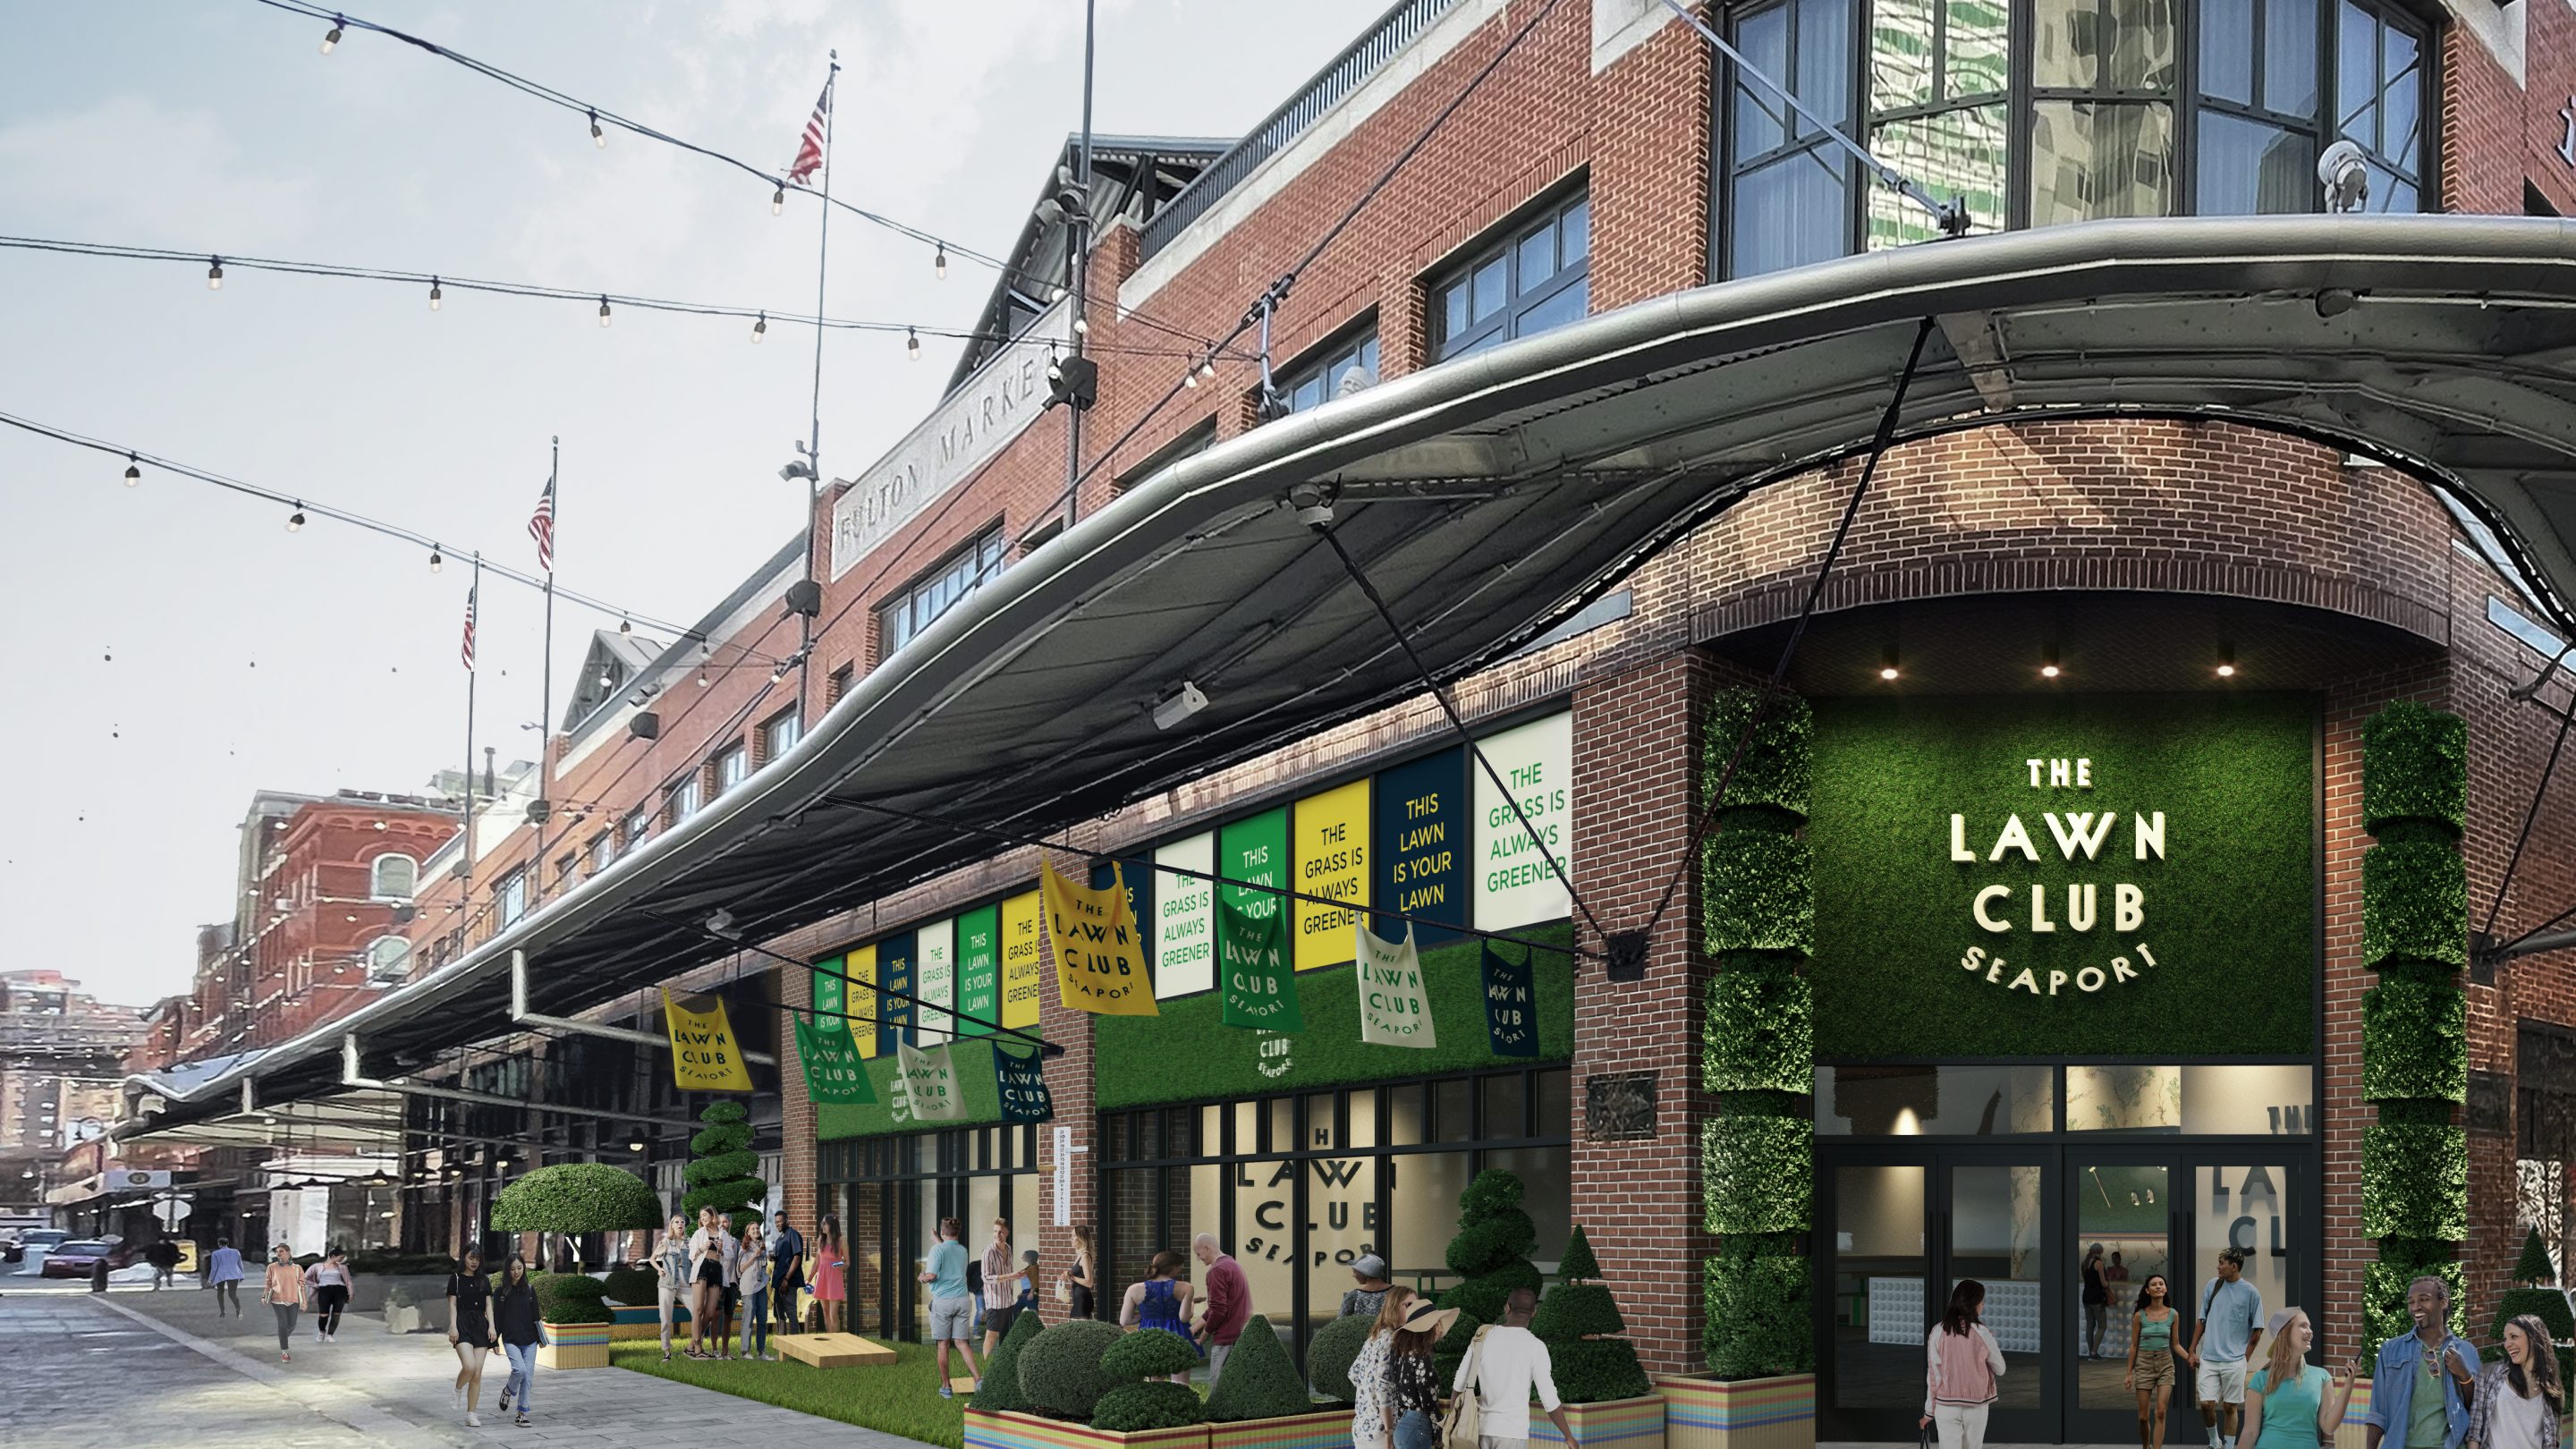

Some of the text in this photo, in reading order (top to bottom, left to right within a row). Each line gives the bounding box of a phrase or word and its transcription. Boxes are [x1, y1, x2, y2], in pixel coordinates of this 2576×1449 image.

[841, 464, 921, 549] FULTON
[1510, 762, 1543, 790] THE
[2027, 758, 2091, 788] THE
[1405, 792, 1438, 820] THIS
[1489, 789, 1565, 828] GRASS IS
[1321, 823, 1346, 846] THE
[1400, 822, 1445, 852] LAWN
[1490, 824, 1559, 860] ALWAYS
[1951, 811, 2165, 863] LAWN
[1243, 845, 1268, 869] THIS
[1305, 847, 1363, 879] GRASS IS
[1176, 869, 1196, 890] THE
[1394, 852, 1452, 885] IS YOUR
[1487, 856, 1567, 893] GREENER
[1239, 871, 1273, 896] LAWN
[1306, 877, 1358, 907] ALWAYS
[1076, 899, 1103, 916] THE
[1163, 891, 1209, 918] GRASS IS
[1246, 897, 1276, 919] YOUR
[1400, 884, 1445, 913] LAWN
[1973, 884, 2145, 932] CLUB
[1018, 919, 1032, 936] THE
[1055, 913, 1129, 945] LAWN
[1164, 918, 1205, 942] ALWAYS
[1239, 927, 1262, 942] THE
[970, 933, 987, 950] THIS
[1009, 941, 1033, 960] GRASS
[930, 947, 943, 962] THE
[968, 953, 989, 971] LAWN
[1064, 948, 1131, 976] CLUB
[1162, 942, 1209, 968] GREENER
[1226, 940, 1280, 967] LAWN
[1375, 950, 1395, 962] THE
[859, 970, 869, 982] THE
[892, 958, 905, 972] THIS
[922, 965, 951, 984] GRASS IS
[1009, 962, 1039, 981] ALWAYS
[1364, 962, 1419, 988] LAWN
[1494, 968, 1513, 981] THE
[1962, 942, 2157, 996] SEAPORT
[825, 979, 836, 993] THIS
[889, 976, 908, 992] LAWN
[965, 972, 993, 991] IS YOUR
[1068, 973, 1133, 999] SEAPORT
[823, 996, 838, 1011] LAWN
[852, 988, 869, 1003] GRASS
[924, 985, 949, 1003] ALWAYS
[968, 995, 989, 1012] LAWN
[1369, 993, 1419, 1014] CLUB
[887, 999, 893, 1012] IS
[688, 1020, 708, 1029] THE
[1367, 1013, 1422, 1035] SEAPORT
[674, 1029, 726, 1046] LAWN
[818, 1038, 836, 1046] THE
[1260, 1038, 1288, 1057] CLUB
[804, 1046, 855, 1063] LAWN
[810, 1066, 857, 1081] CLUB
[999, 1070, 1044, 1085] LAWN
[1004, 1089, 1046, 1103] CLUB
[2213, 1166, 2277, 1195] LA
[1256, 1200, 1376, 1231] CUB
[2229, 1216, 2285, 1257] CL
[1245, 1237, 1376, 1267] SEPOR
